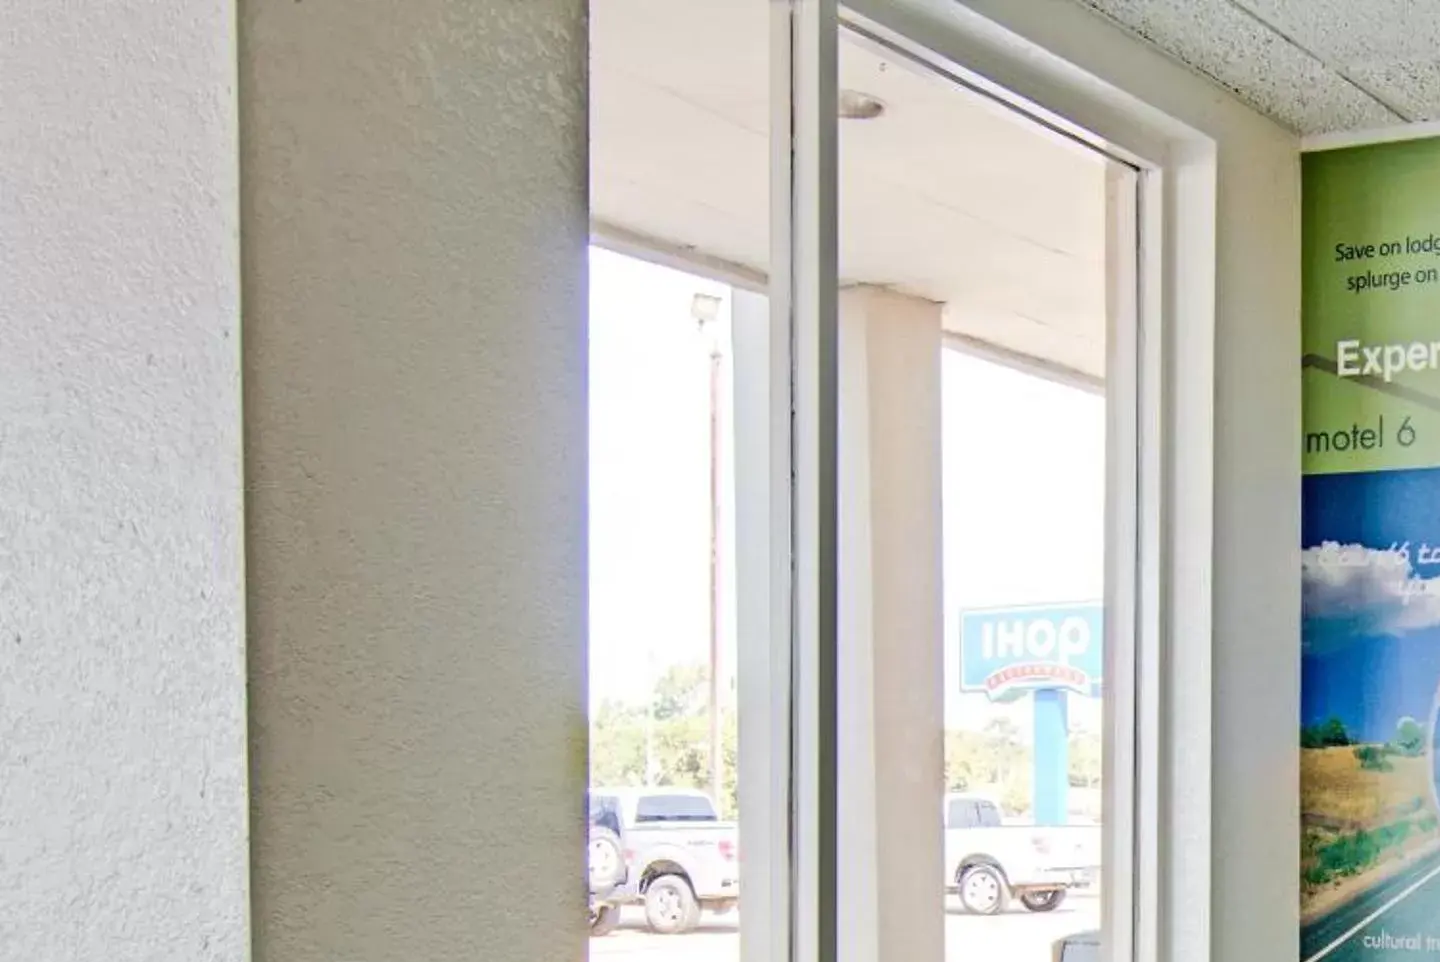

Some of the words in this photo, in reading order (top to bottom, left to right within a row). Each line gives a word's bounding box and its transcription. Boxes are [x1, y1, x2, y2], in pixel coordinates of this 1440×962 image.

[1334, 242, 1375, 262] Save
[1379, 240, 1401, 256] on
[1347, 271, 1411, 294] splurge
[1414, 268, 1437, 285] on
[1305, 414, 1383, 453] motel
[1396, 416, 1416, 447] 6
[1363, 928, 1422, 951] cultural
